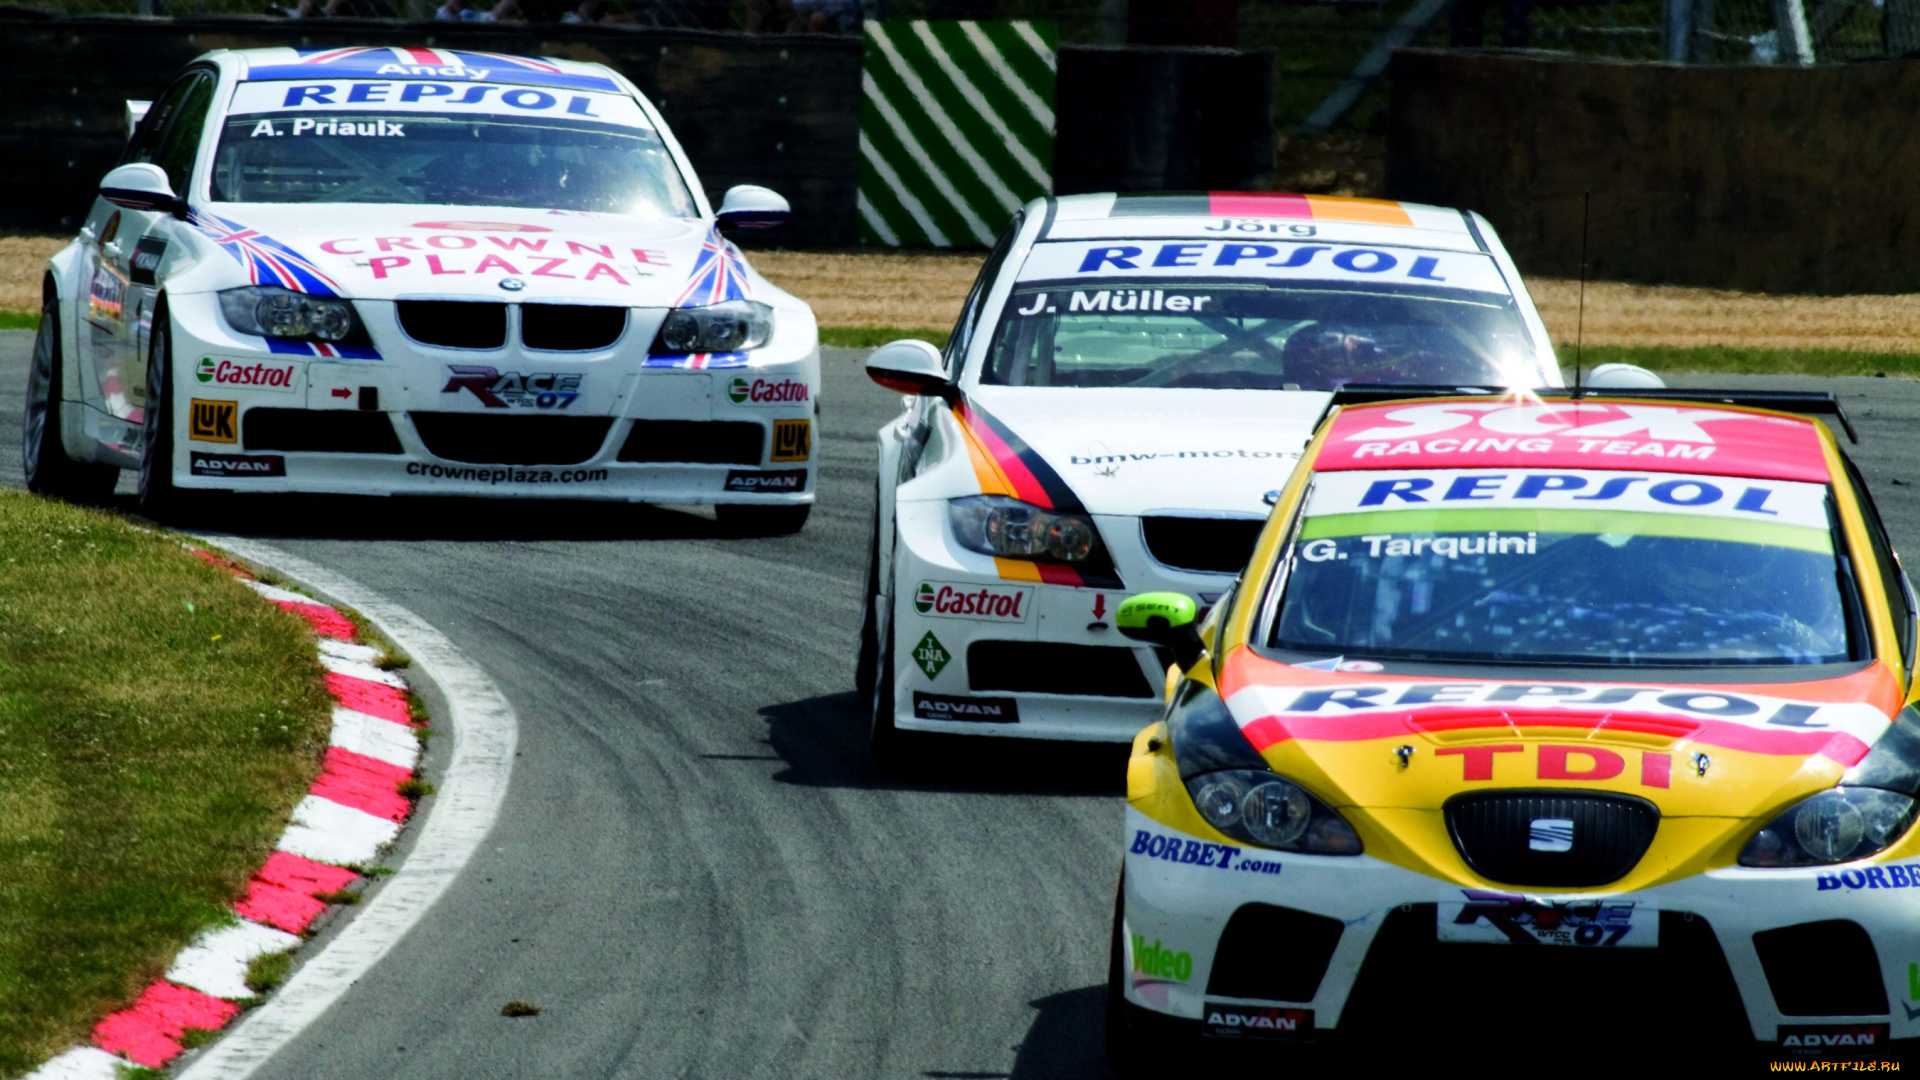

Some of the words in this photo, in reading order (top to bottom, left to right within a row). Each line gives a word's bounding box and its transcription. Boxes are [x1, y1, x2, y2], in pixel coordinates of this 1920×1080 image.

[377, 63, 490, 81] Andy
[282, 83, 600, 118] REPSOL
[251, 119, 284, 137] A.
[293, 118, 405, 138] Priaulx
[1204, 218, 1317, 237] Jörg
[319, 234, 671, 268] CROWNE
[1078, 243, 1446, 281] REPSOL
[369, 254, 630, 286] PLAZA
[1018, 293, 1056, 316] J.
[1069, 290, 1211, 313] Müller
[216, 360, 294, 388] Castrol
[441, 365, 583, 408] RACE
[536, 392, 580, 409] 07
[1345, 403, 1758, 444] SCX
[1352, 437, 1555, 459] RACING
[1577, 438, 1717, 461] TEAM
[194, 459, 270, 472] ADVAN
[407, 461, 608, 485] crowneplaza.com
[730, 477, 798, 487] ADVAN
[1358, 474, 1778, 516] REPSOL
[1303, 536, 1348, 562] G.
[1363, 531, 1537, 560] Tarquini
[935, 585, 1023, 618] Castrol
[918, 700, 1001, 715] ADVAN
[1284, 683, 1830, 728] REPSOL
[1435, 744, 1671, 789] TDI
[1129, 829, 1282, 876] BORBET.com
[1537, 930, 1571, 939] WTCC
[1574, 924, 1633, 947] 07
[1131, 933, 1193, 982] Valeo
[1208, 1012, 1296, 1030] ADVAN
[1783, 1034, 1875, 1047] ADVAN
